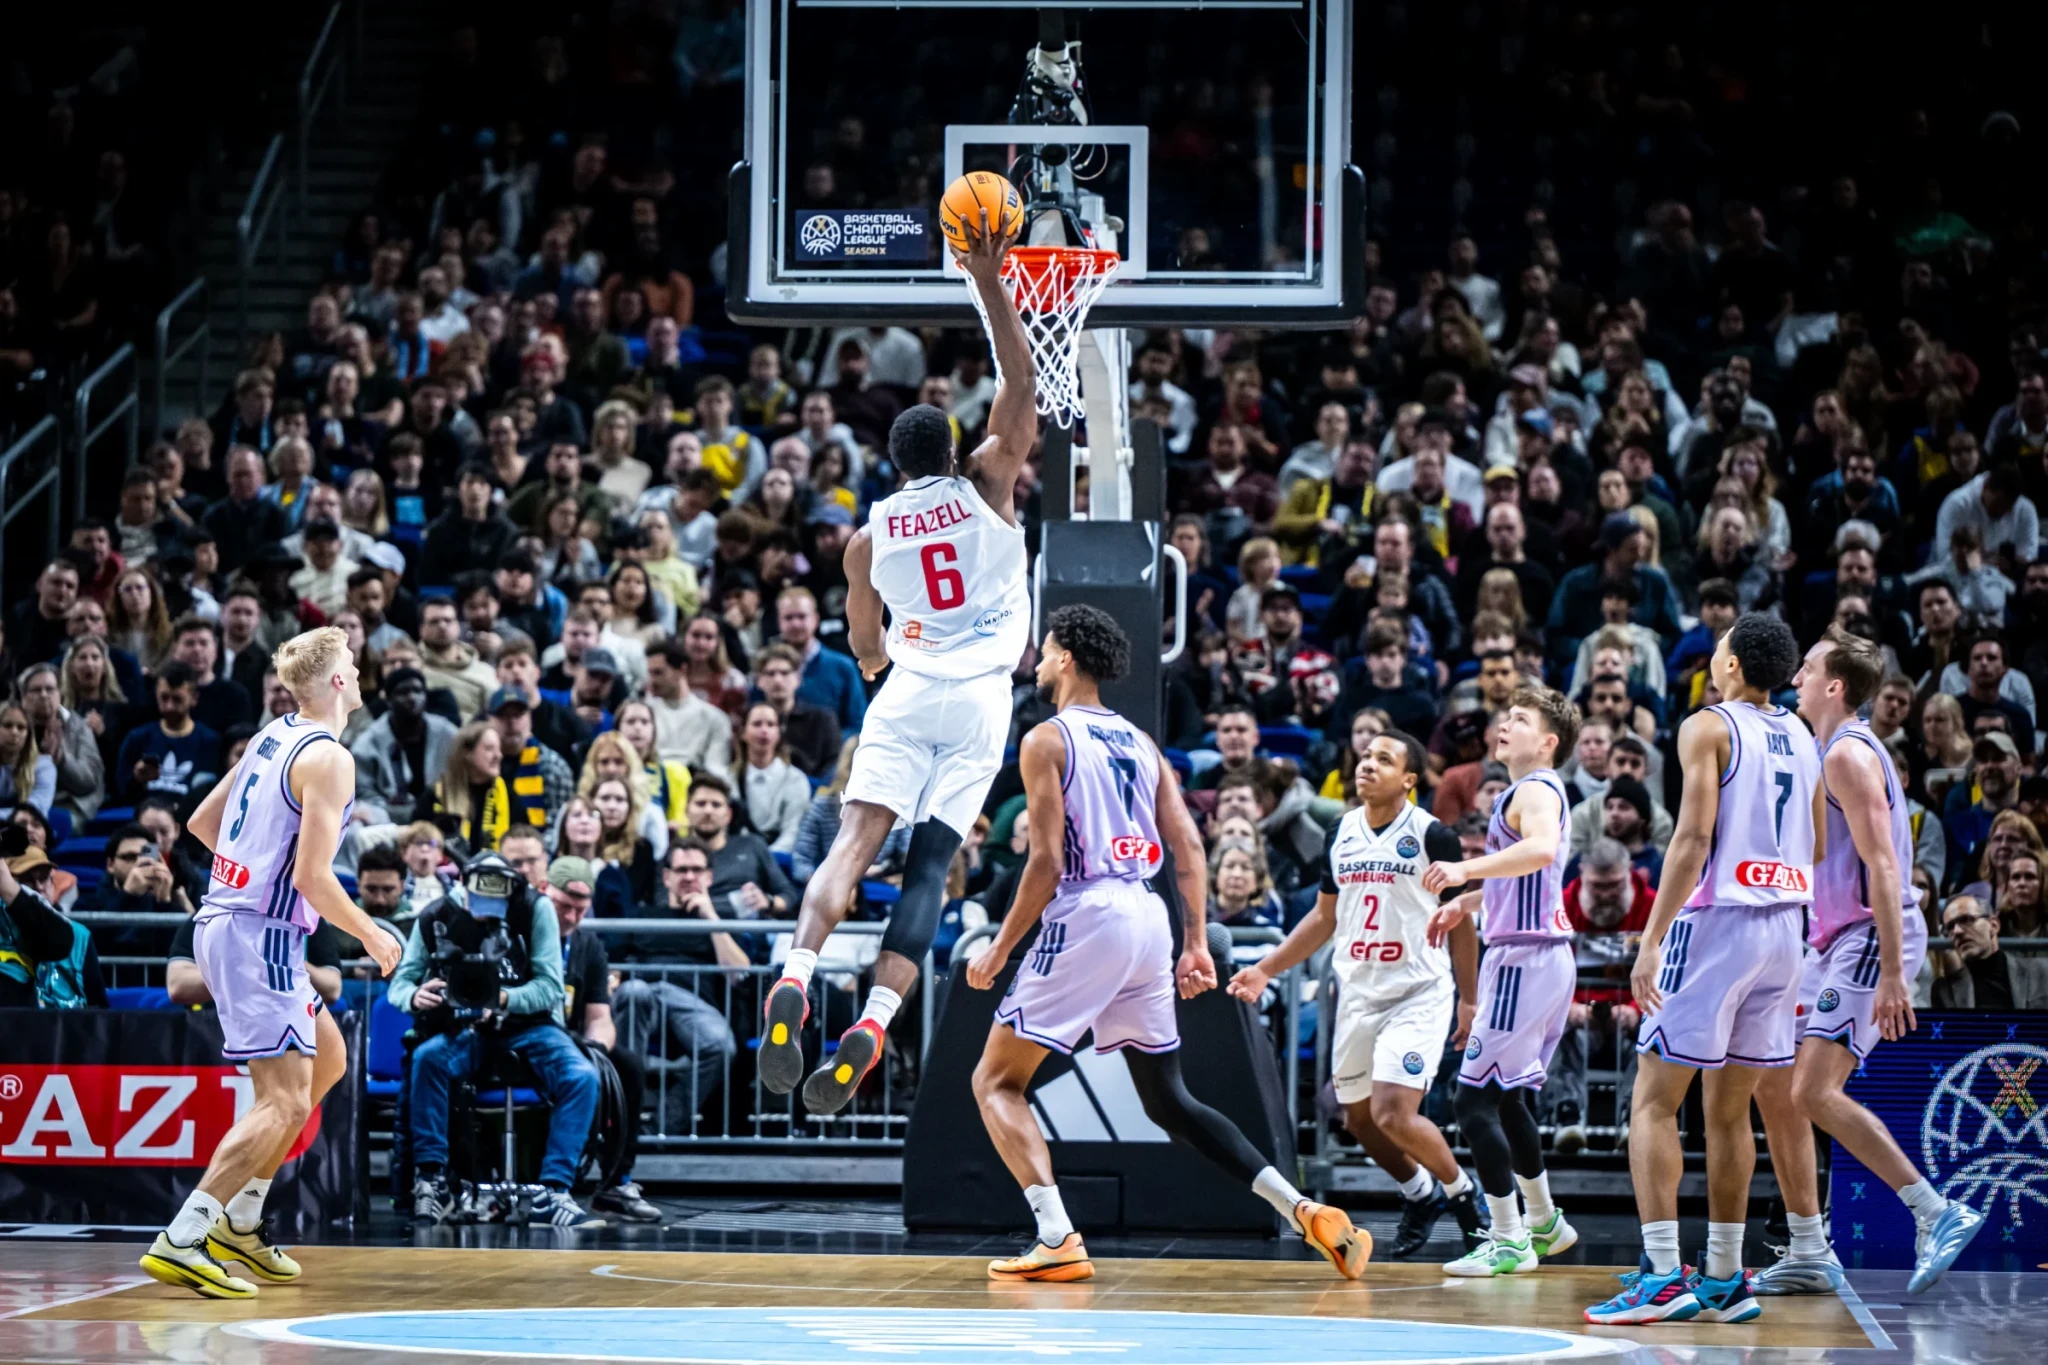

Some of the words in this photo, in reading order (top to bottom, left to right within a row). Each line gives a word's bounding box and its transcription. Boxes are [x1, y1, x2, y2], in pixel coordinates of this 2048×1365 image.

[843, 214, 914, 224] BASKETBALL
[843, 224, 923, 235] CHAMPIONS
[843, 235, 887, 245] LEAGUE
[844, 247, 877, 255] SEASON
[879, 247, 886, 255] X
[888, 499, 972, 538] FEAZELL
[920, 542, 966, 611] 6
[229, 772, 260, 842] 5
[1774, 771, 1794, 848] 7
[1338, 860, 1416, 876] BASKETBALL
[1364, 894, 1379, 931] 2
